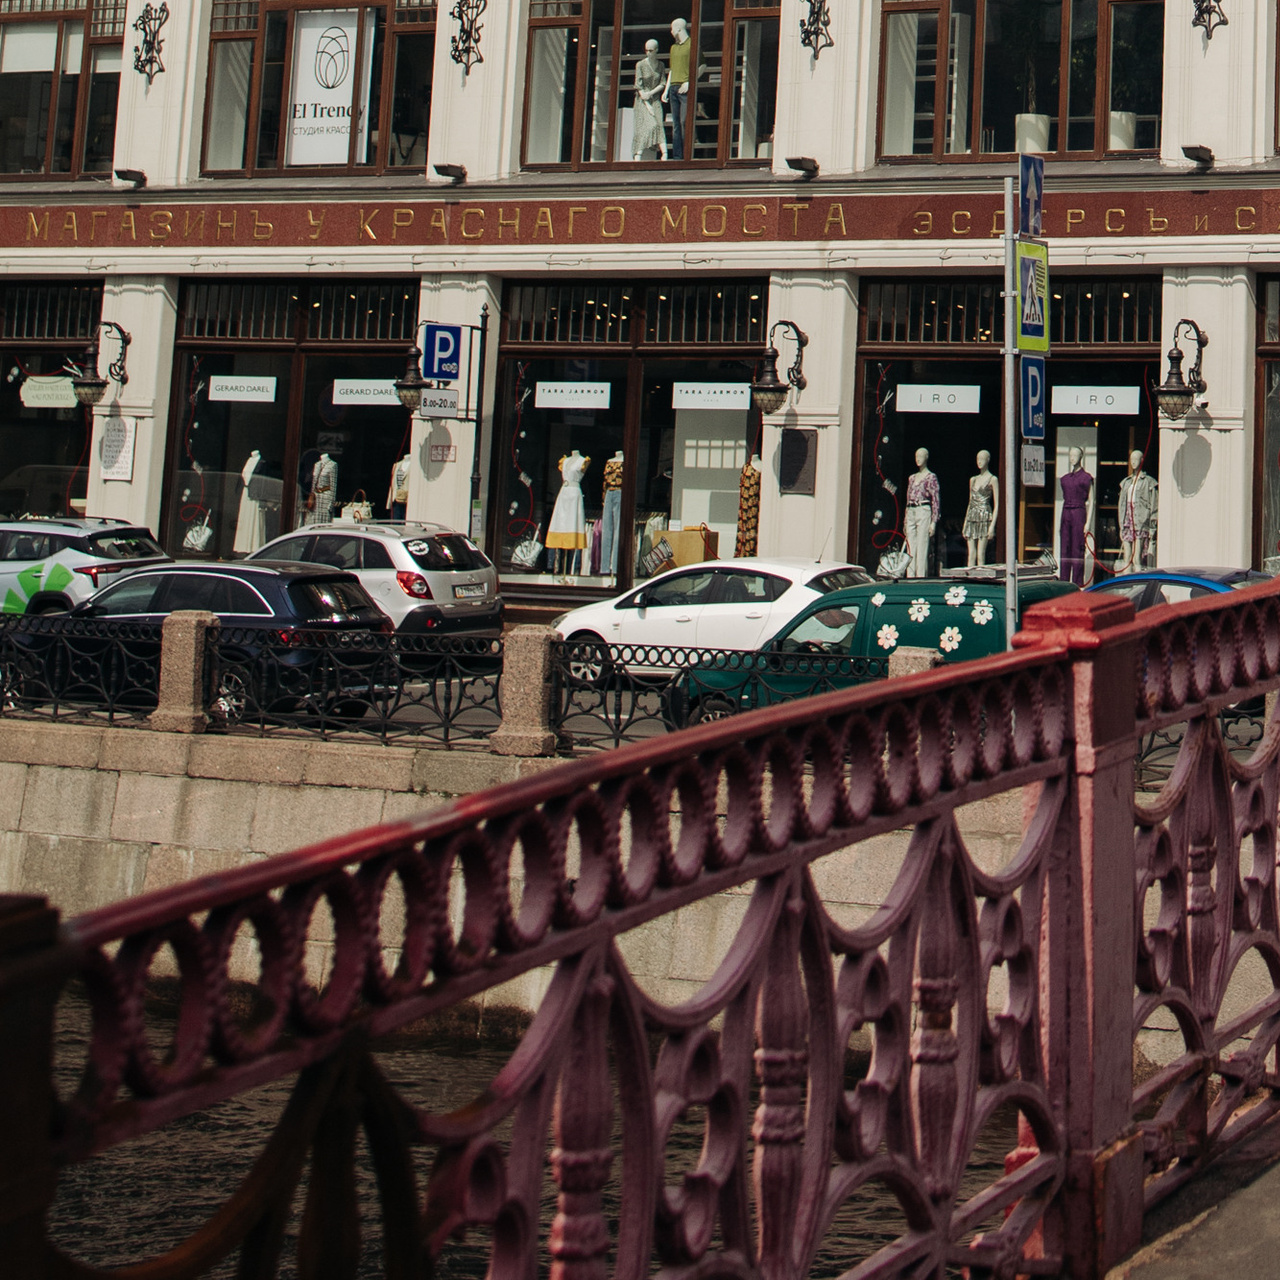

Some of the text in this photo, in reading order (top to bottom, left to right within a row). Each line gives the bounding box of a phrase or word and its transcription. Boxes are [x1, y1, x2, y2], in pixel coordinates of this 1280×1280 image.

[292, 104, 307, 119] El
[293, 127, 324, 136] СТУДИЯ
[26, 209, 274, 240] МАГАЗИНЪ
[308, 209, 326, 239] У
[359, 206, 626, 240] КРАСНАГО
[661, 203, 848, 238] МОСТА
[215, 384, 270, 393] GERARD DAREL
[919, 393, 956, 404] IRO
[1076, 395, 1115, 405] IRO
